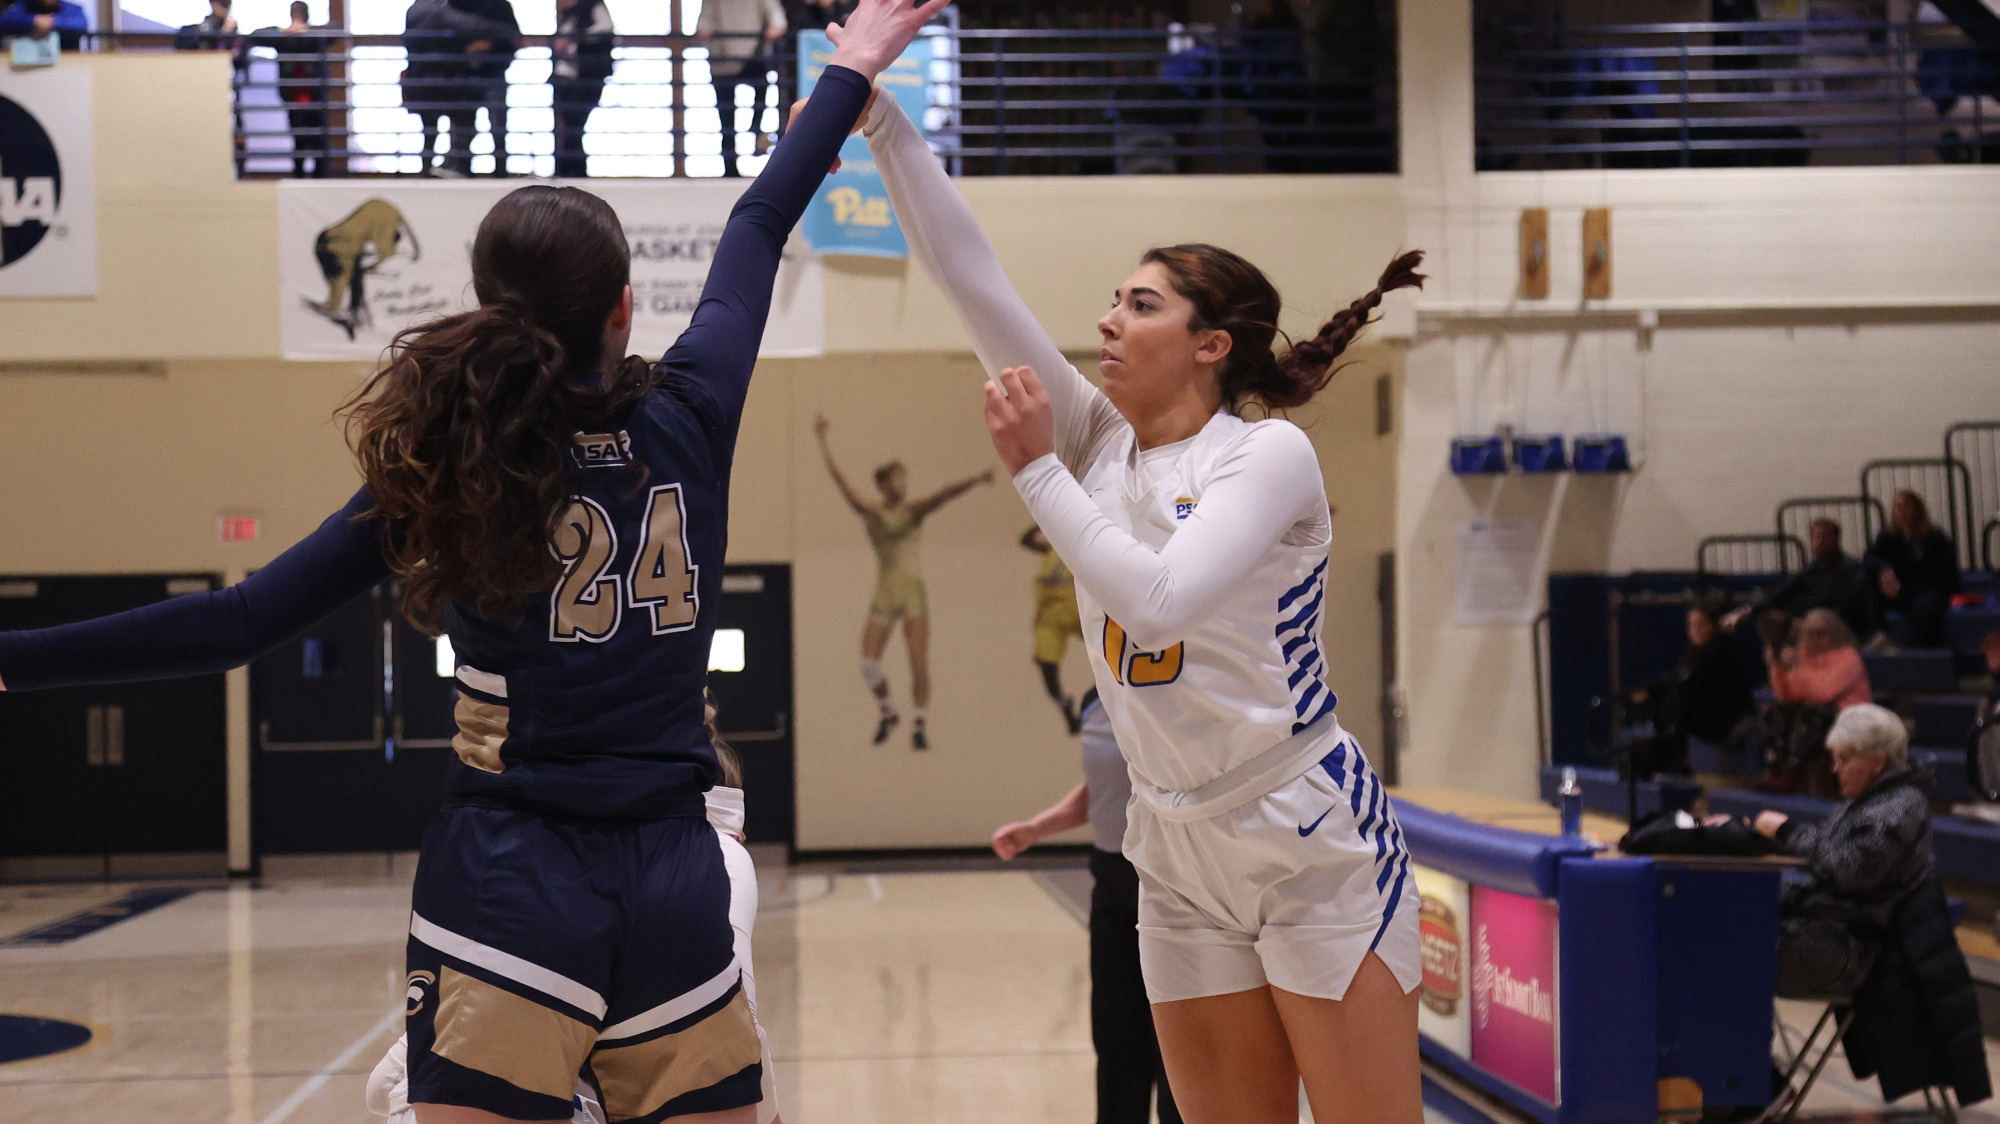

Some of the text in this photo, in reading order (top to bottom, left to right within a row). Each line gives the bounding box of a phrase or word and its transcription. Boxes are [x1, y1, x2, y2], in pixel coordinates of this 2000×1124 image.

[576, 442, 630, 459] SA
[1176, 502, 1198, 515] PS
[547, 483, 699, 642] 24
